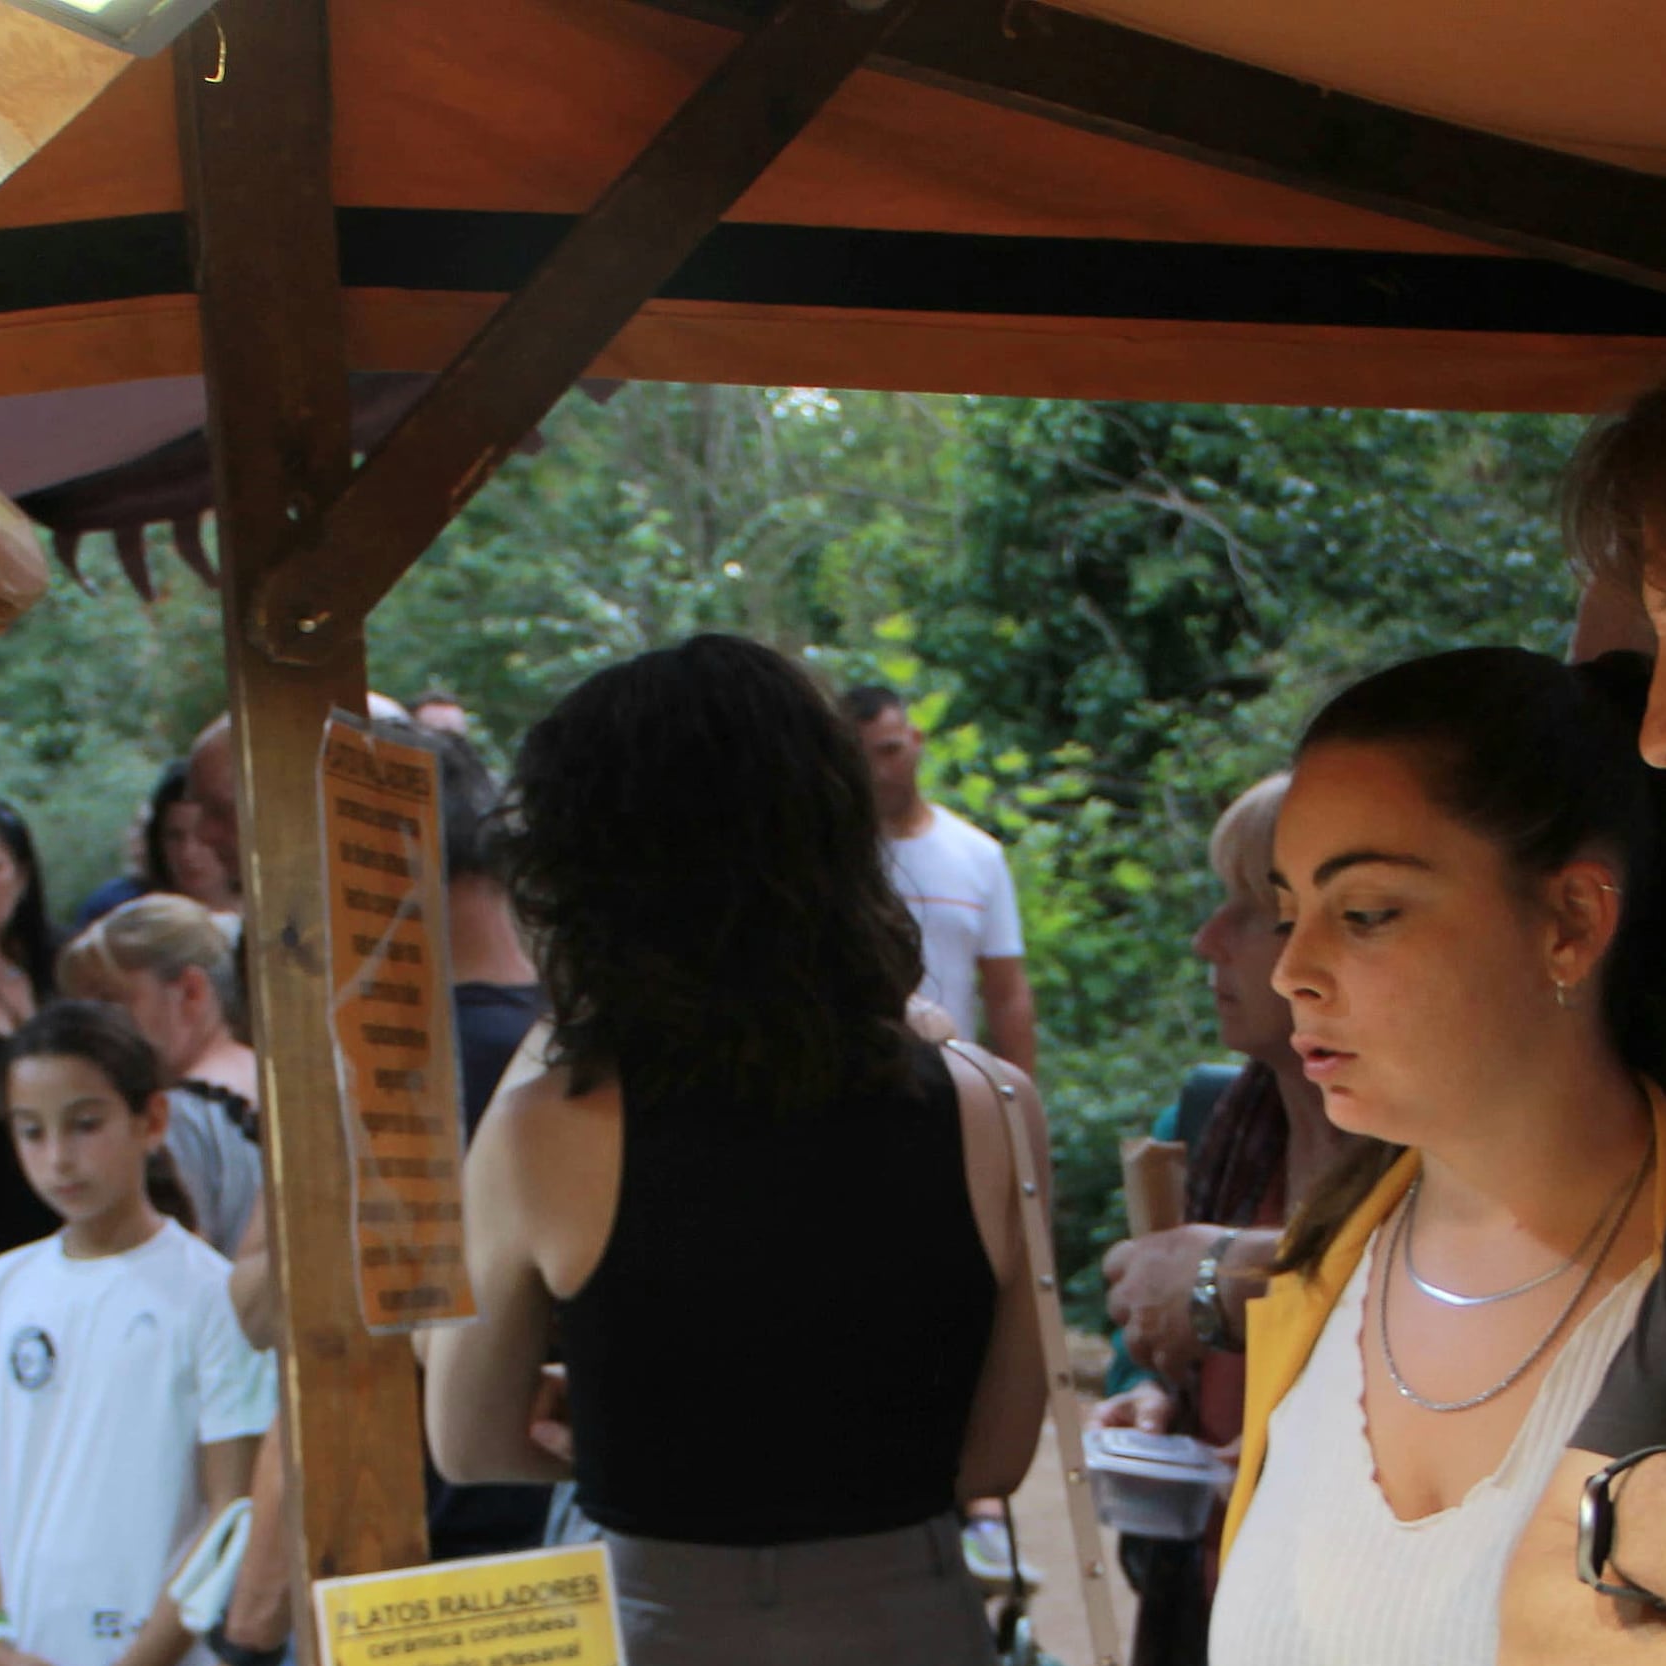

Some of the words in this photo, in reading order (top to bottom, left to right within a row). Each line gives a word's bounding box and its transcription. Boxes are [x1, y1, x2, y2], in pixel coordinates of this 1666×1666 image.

[334, 1598, 431, 1634] PLATOS
[436, 1572, 599, 1618] RALLADORES
[365, 1626, 463, 1661] cerámica
[467, 1609, 578, 1644] cordobesa
